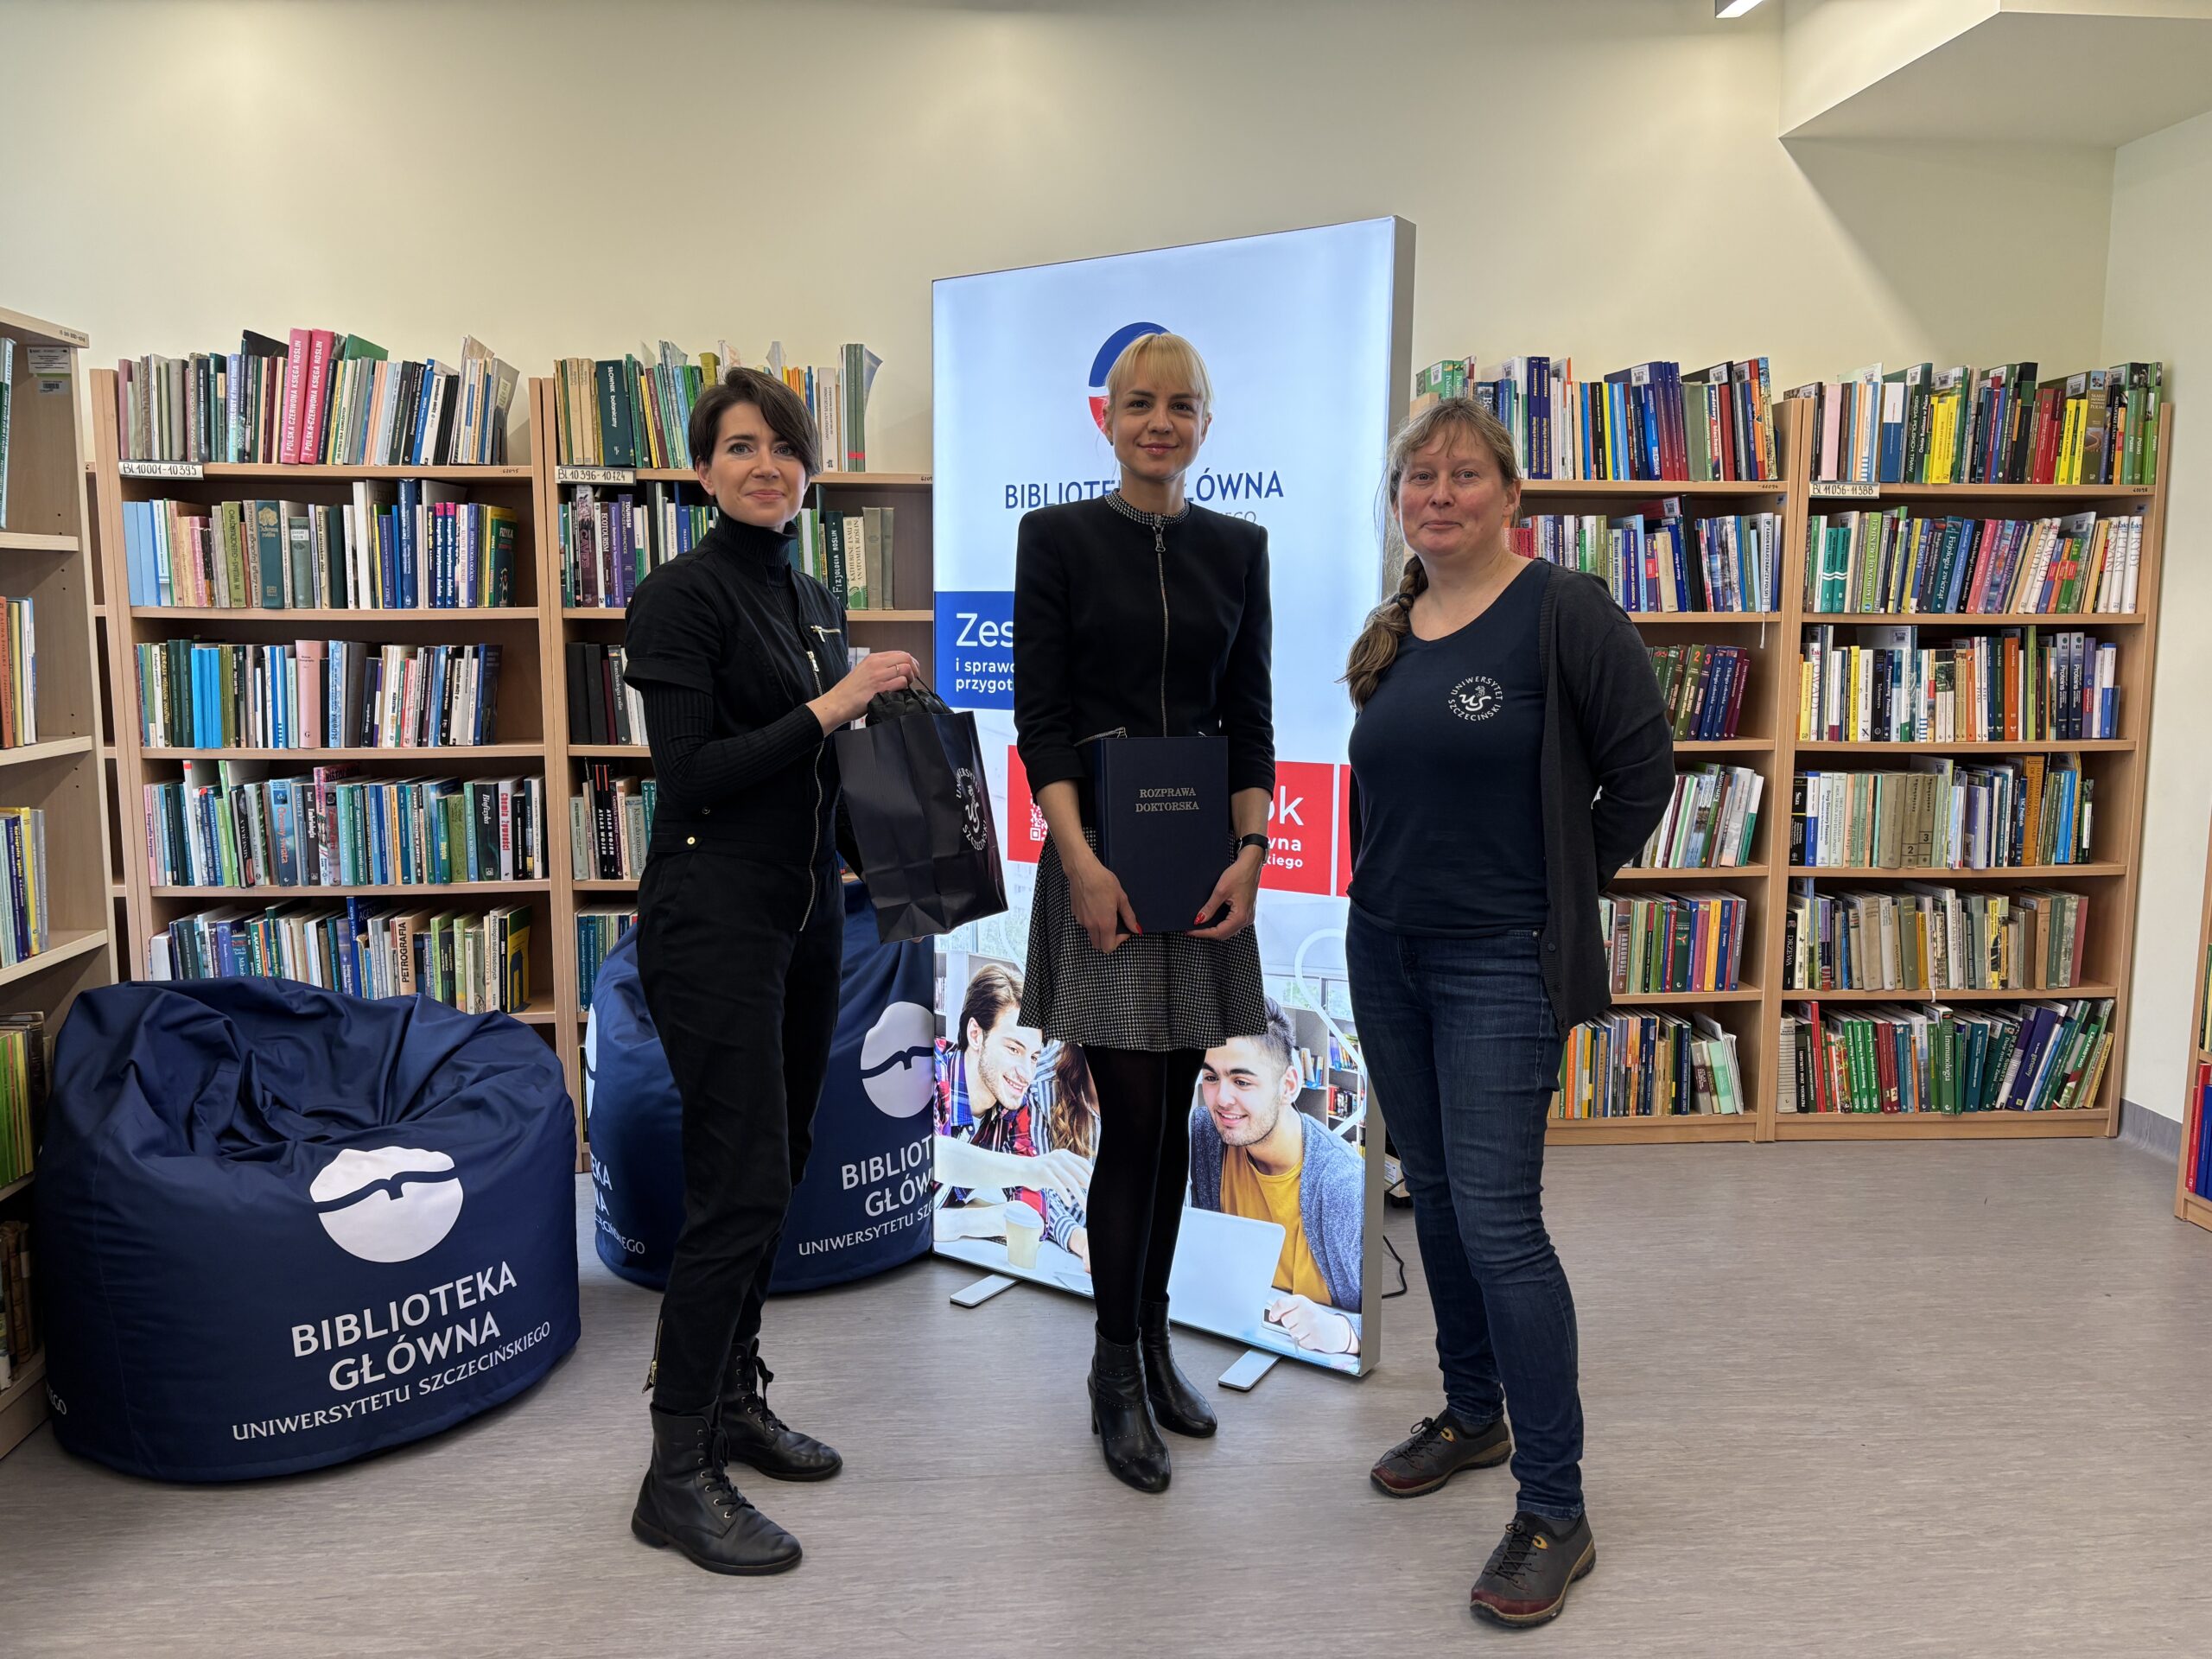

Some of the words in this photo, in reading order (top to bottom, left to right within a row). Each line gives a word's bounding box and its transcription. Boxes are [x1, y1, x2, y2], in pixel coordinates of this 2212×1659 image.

[290, 365, 301, 389] KSIĘGA
[312, 365, 321, 389] KSIĘGA
[607, 365, 615, 393] SŁOWNIK
[288, 389, 298, 425] CZERWONA
[307, 390, 318, 424] CZERWONA
[609, 394, 618, 429] botaniczny
[286, 426, 295, 451] POLSKA
[304, 426, 315, 451] POLSKA
[1005, 480, 1121, 509] BIBLIOTE
[601, 512, 610, 552] ECOTOURISM
[852, 518, 861, 544] ROŚLIN
[847, 546, 855, 582] KATHERINE
[1916, 544, 1927, 569] Bioetyka
[1943, 536, 1957, 569] Fizjologia
[2129, 537, 2140, 569] RYBY
[1937, 570, 1949, 600] zwierząt
[956, 658, 960, 673] i
[1694, 651, 1700, 662] 2
[1705, 653, 1712, 664] 3
[613, 660, 621, 696] Biotechnologia
[1451, 675, 1503, 702] UNIWERSYTET
[1448, 696, 1503, 722] SZCZECIŃSKI
[1135, 800, 1199, 813] DOKTORSKA
[1139, 786, 1197, 799] ROZPRAWA
[481, 793, 492, 824] Biofizyka
[632, 807, 642, 826] Klucz
[1907, 846, 1914, 855] 2
[397, 922, 410, 983] PETROGRAFIA
[1786, 935, 1795, 966] DRZEWA
[1942, 1035, 1953, 1082] Immunologia
[2024, 1053, 2038, 1077] genomy
[1891, 1089, 1897, 1097] 2
[798, 1211, 913, 1257] UNIWERSYTETU
[290, 1260, 518, 1358] BIBLIOTEKA
[327, 1310, 502, 1394] GŁÓWNA
[232, 1384, 411, 1441] UNIWERSYTETU
[418, 1320, 552, 1397] SZCZECIŃSKIEGO
